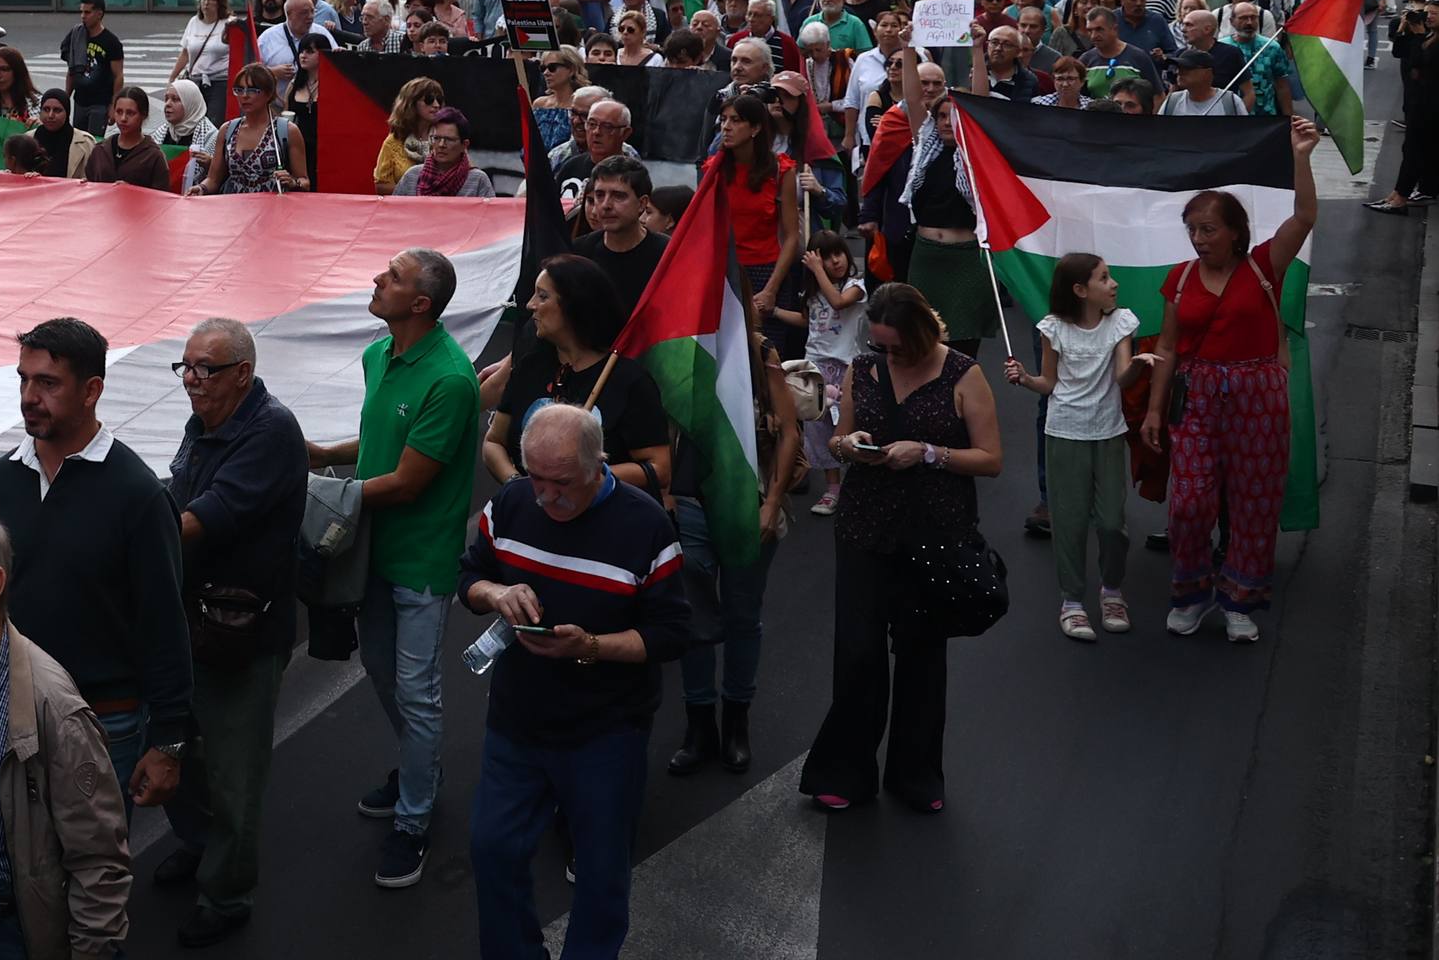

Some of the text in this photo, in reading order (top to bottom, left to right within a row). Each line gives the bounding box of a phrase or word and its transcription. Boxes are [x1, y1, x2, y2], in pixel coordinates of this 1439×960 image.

[941, 1, 971, 16] ISRAEL
[507, 18, 536, 26] Palestina
[926, 30, 955, 41] AGAIN
